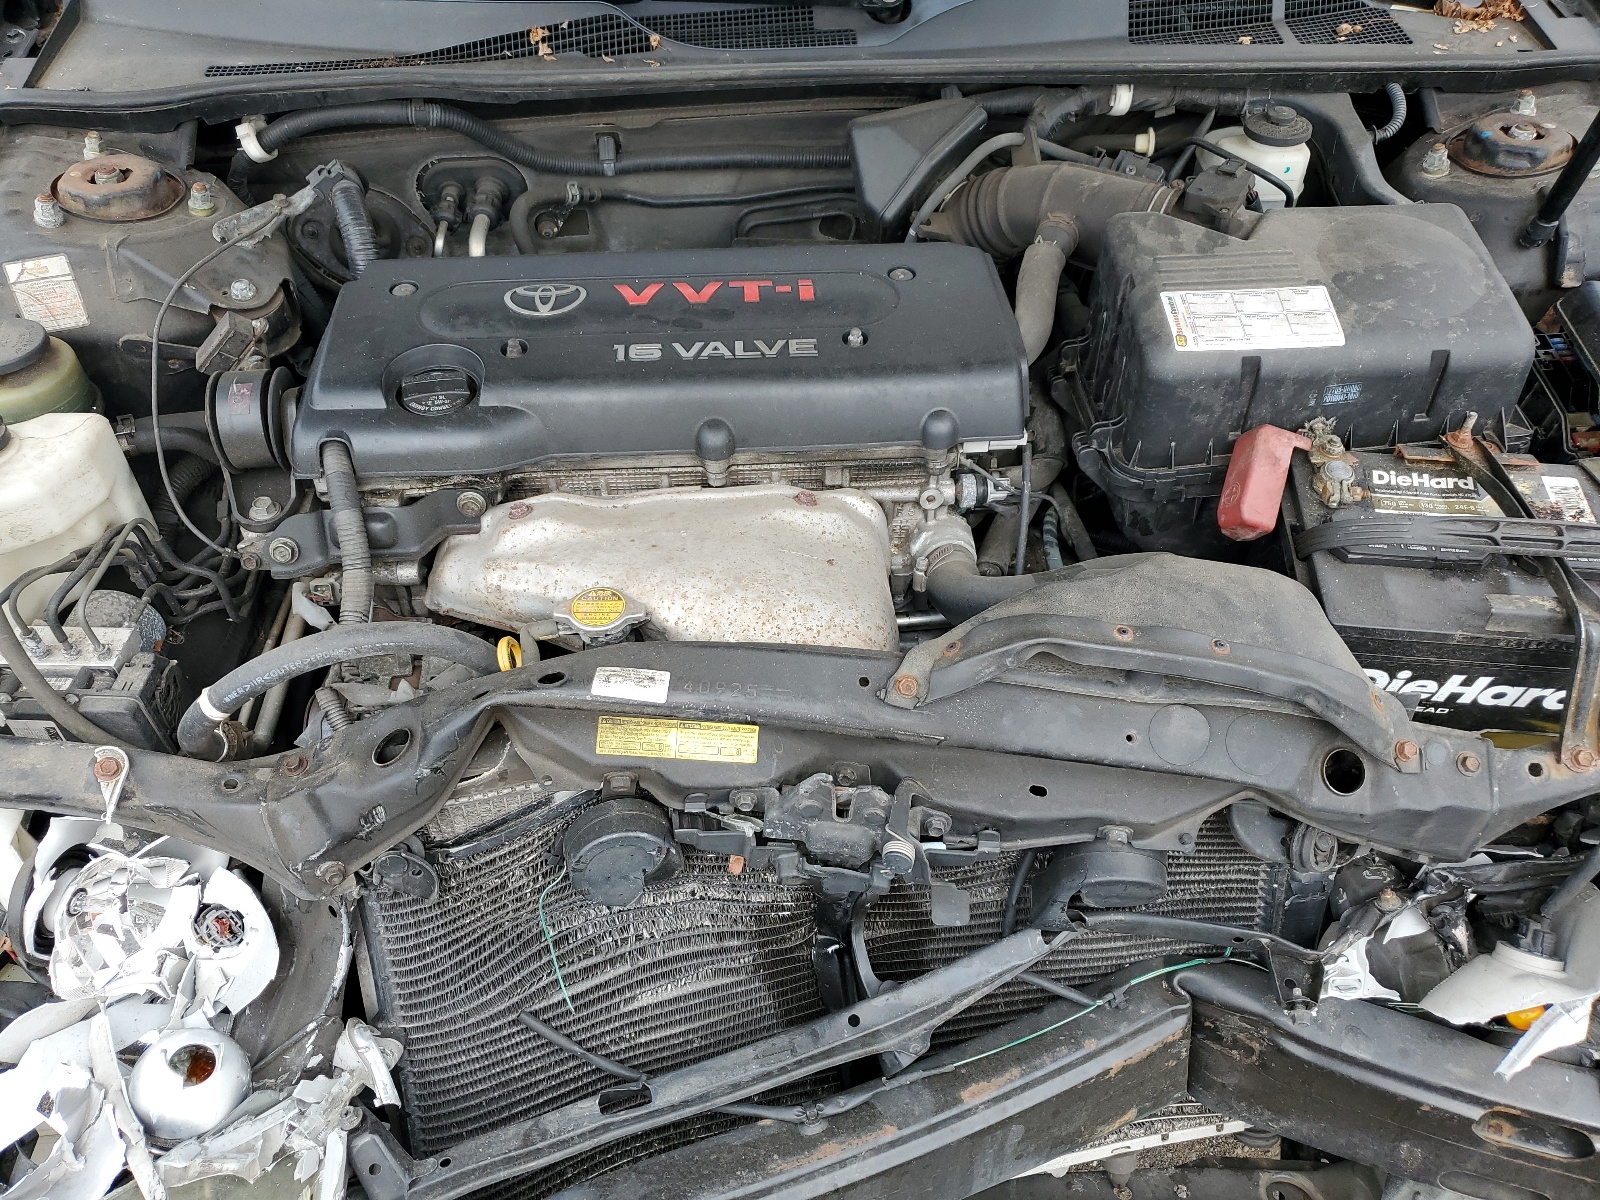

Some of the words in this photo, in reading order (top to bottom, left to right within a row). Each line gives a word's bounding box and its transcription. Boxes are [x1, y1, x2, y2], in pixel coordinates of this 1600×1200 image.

[613, 279, 815, 306] VVT-i
[613, 342, 663, 363] 16
[671, 338, 819, 361] VALVE
[1372, 469, 1475, 490] DieHard
